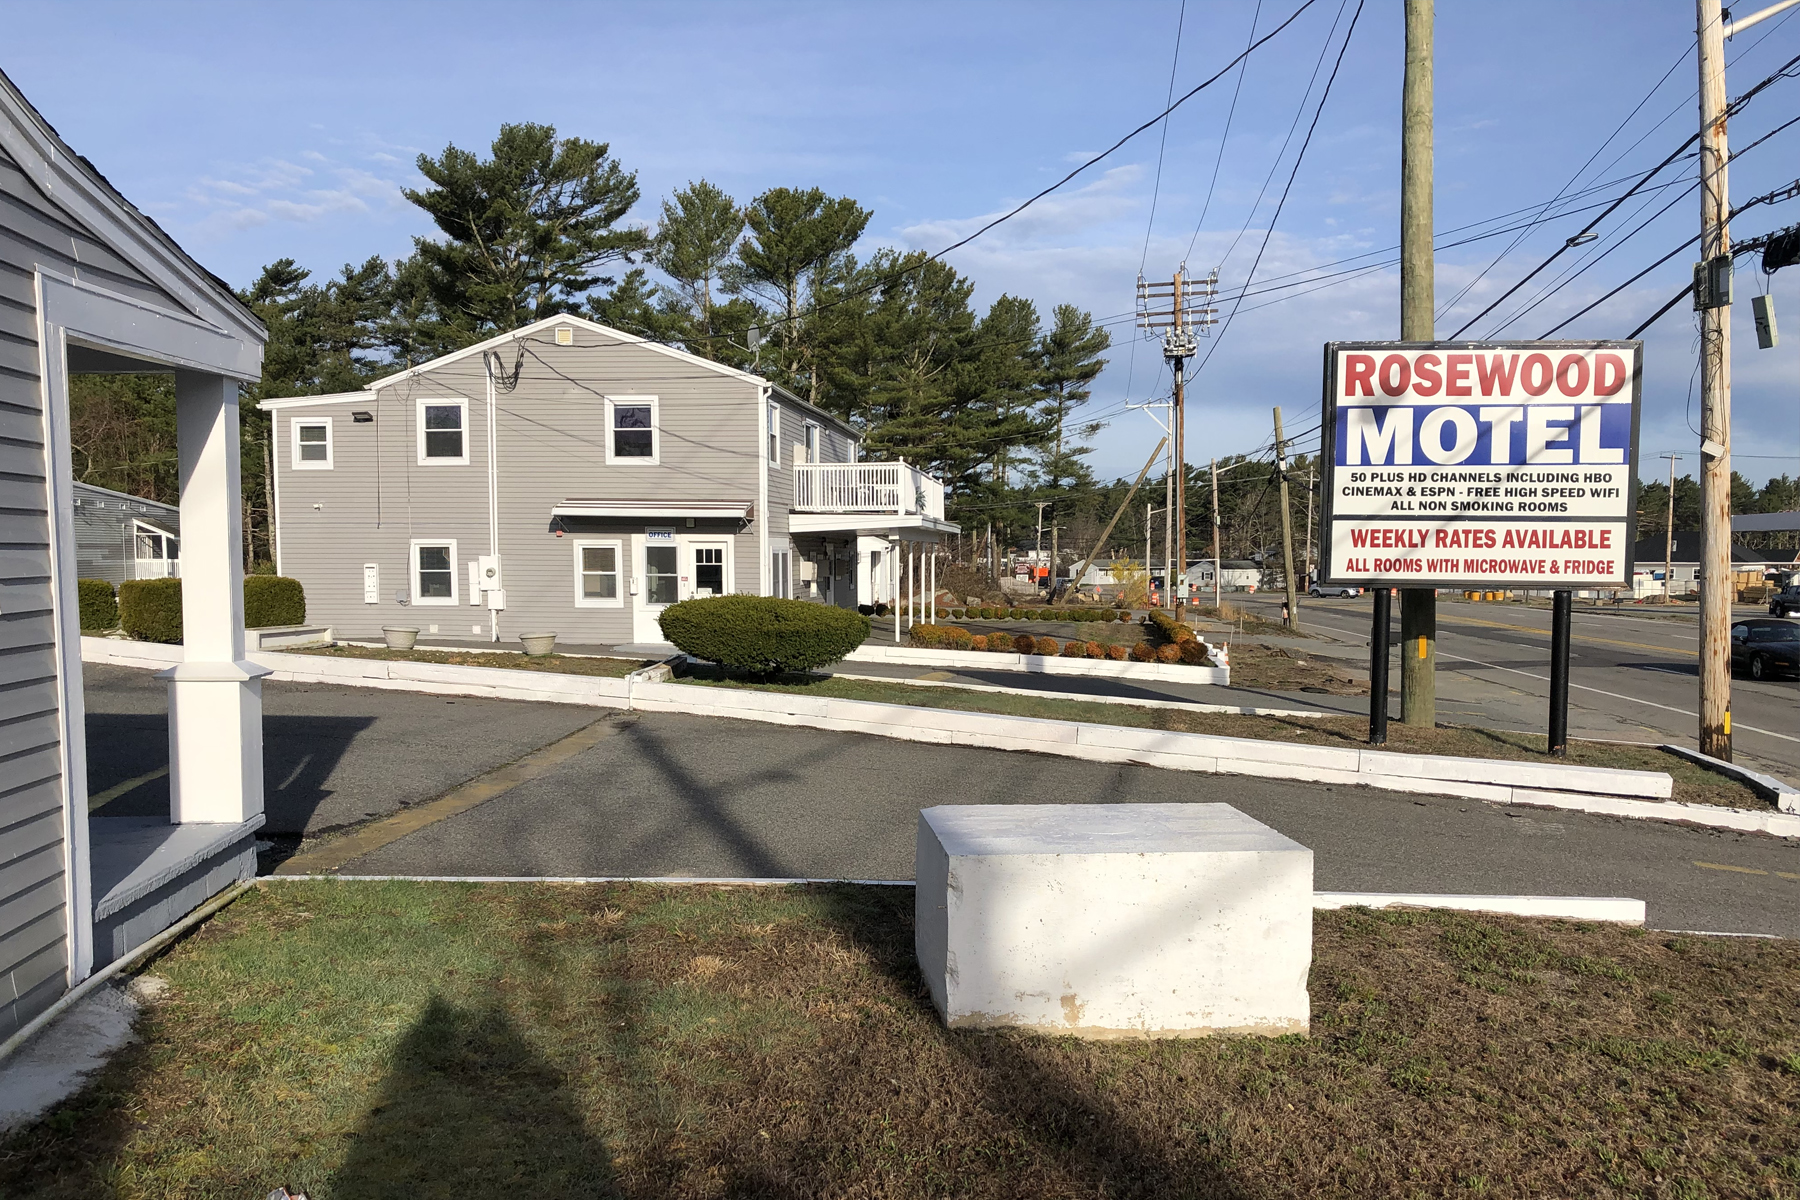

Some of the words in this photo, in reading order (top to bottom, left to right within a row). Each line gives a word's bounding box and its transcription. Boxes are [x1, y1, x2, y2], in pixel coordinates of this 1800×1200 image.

[1344, 353, 1627, 397] ROSEWOOD
[1346, 406, 1624, 465] MOTEL
[1350, 472, 1367, 483] 50
[1371, 472, 1405, 483] PLUS
[1408, 472, 1427, 483] HD
[1430, 472, 1502, 483] CHANNELS
[1506, 472, 1580, 483] INCLUDING
[1583, 472, 1613, 483] HBO
[1342, 486, 1403, 497] CINEMAX
[1406, 486, 1417, 497] &
[1420, 486, 1456, 497] ESPN
[1466, 487, 1501, 497] FREE
[1504, 487, 1538, 498] HIGH
[1541, 487, 1586, 498] SPEED
[1589, 487, 1620, 498] WIFI
[1390, 500, 1415, 511] ALL
[1418, 500, 1447, 511] NON
[1450, 501, 1514, 512] SMOKING
[1517, 501, 1568, 513] ROOMS
[1350, 528, 1430, 548] WEEKLY
[1435, 528, 1497, 549] RATES
[1501, 529, 1612, 549] AVAILABLE
[1345, 557, 1370, 573] ALL
[1373, 557, 1423, 573] ROOMS
[1426, 558, 1460, 573] WITH
[1463, 558, 1547, 574] MICROWAVE
[1549, 559, 1560, 574] &
[1563, 559, 1615, 575] FRIDGE
